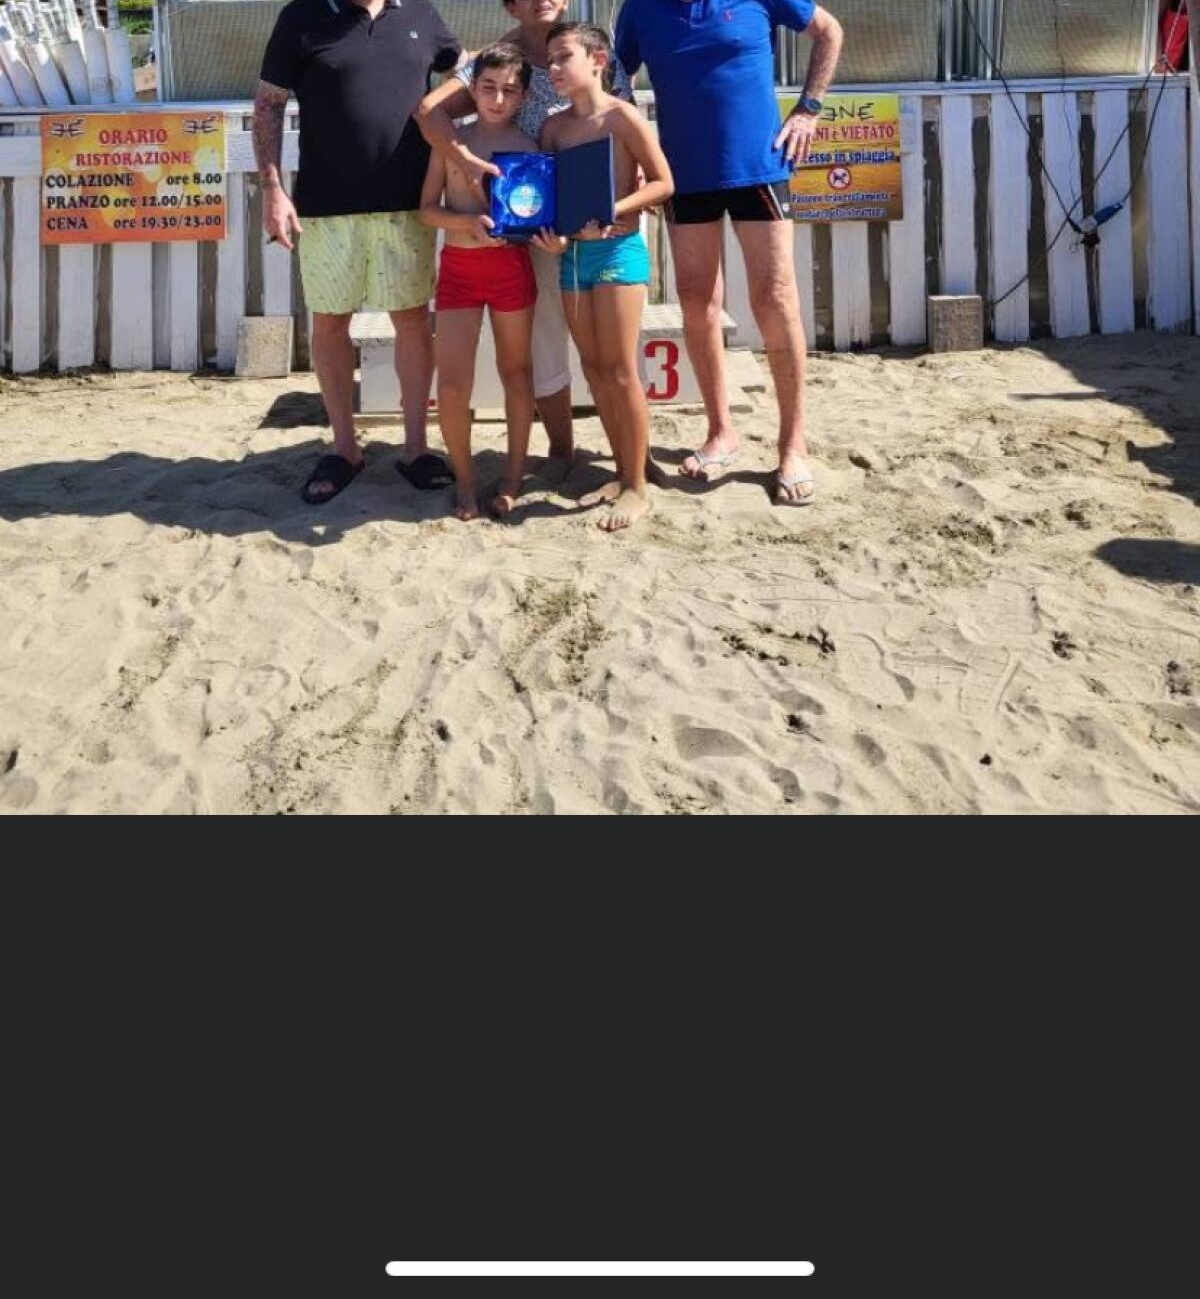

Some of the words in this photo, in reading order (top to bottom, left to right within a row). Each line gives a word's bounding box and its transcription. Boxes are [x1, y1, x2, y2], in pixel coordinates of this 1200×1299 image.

[98, 129, 168, 144] ORARIO
[842, 125, 894, 140] VIETATO
[76, 151, 191, 166] RISTORAZIONE
[834, 150, 846, 162] in
[848, 147, 895, 164] spiaggia
[45, 173, 134, 188] COLAZIONE
[166, 175, 190, 185] ore
[193, 173, 222, 184] 8.00
[47, 195, 110, 209] PRANZO
[113, 198, 137, 207] ore
[141, 194, 222, 208] 12.00/15.00
[47, 216, 88, 230] CENA
[113, 219, 136, 229] ore
[142, 215, 222, 229] 19.30/23.00
[644, 340, 680, 400] 3
